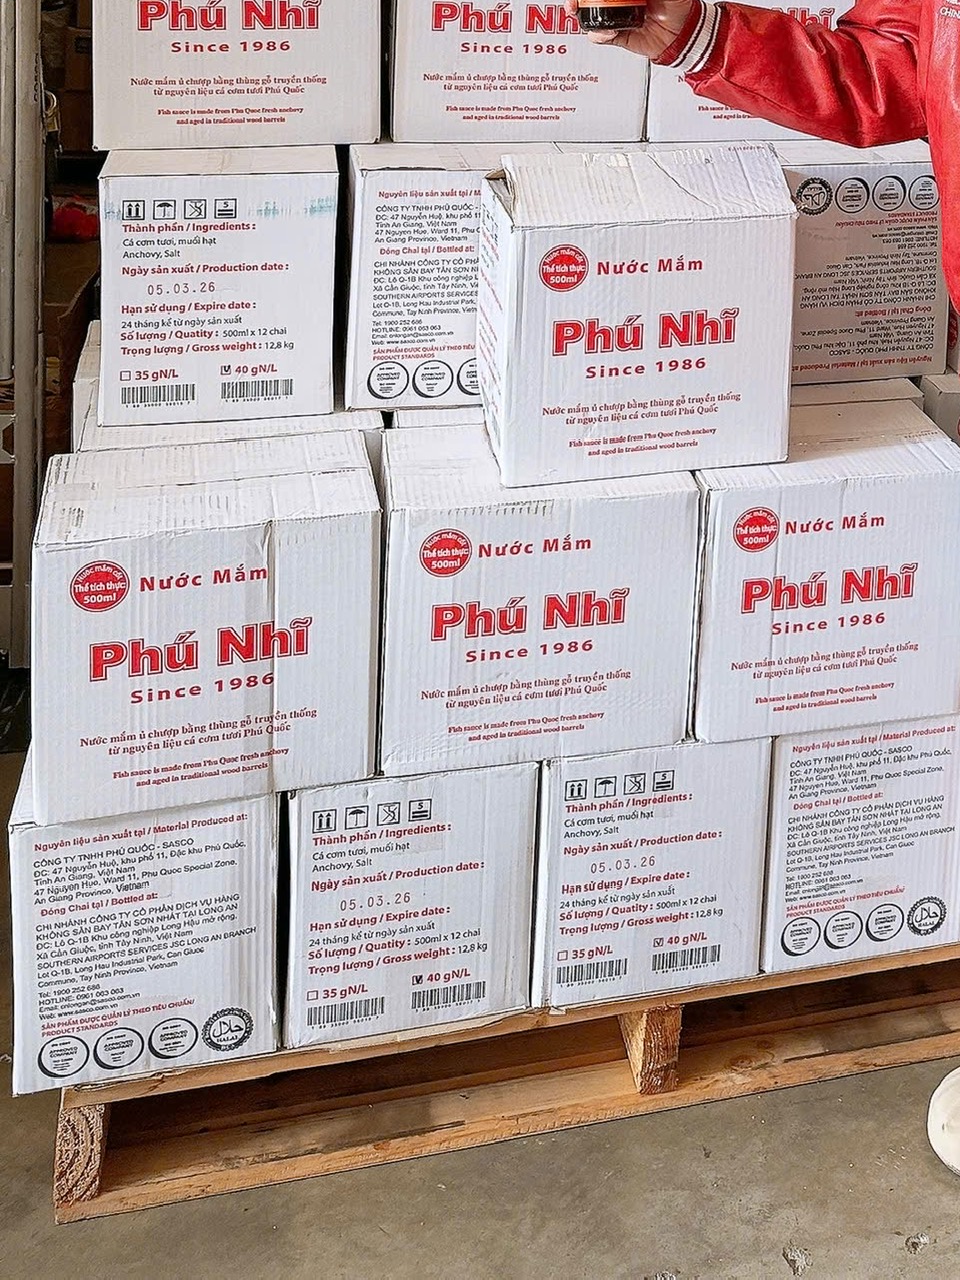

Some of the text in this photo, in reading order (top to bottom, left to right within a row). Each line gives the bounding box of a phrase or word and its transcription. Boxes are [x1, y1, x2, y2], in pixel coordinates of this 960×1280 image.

[431, 0, 587, 34] Phú Nh
[169, 40, 292, 54] Since 1986
[460, 42, 568, 56] Since 1986
[123, 236, 217, 247] Cá cơm tươi, muối hạt
[122, 250, 163, 260] Anchovy,
[595, 257, 703, 276] Nước Mắm
[147, 282, 216, 295] 05.03.26
[552, 308, 740, 357] Phú Nhĩ
[135, 369, 179, 381] 35 gN/L
[586, 358, 707, 379] Since 1986
[784, 513, 885, 535] Nước Mắm
[478, 537, 592, 557] Nước Mắm
[139, 565, 268, 592] Nước Mắm
[740, 564, 916, 614] Phú Nhĩ
[431, 588, 629, 642] Phú Nhĩ
[771, 612, 886, 635] Since 1986
[89, 618, 312, 681] Phú Nhĩ
[466, 640, 592, 663] Since 1986
[131, 674, 273, 704] Since 1986
[80, 736, 108, 747] Nước
[110, 732, 137, 743] mắm
[148, 727, 179, 741] chượp
[181, 724, 207, 735] bằng
[208, 719, 238, 731] thùng
[240, 715, 252, 728] gỗ
[254, 712, 288, 726] truyền
[289, 707, 317, 719] thống
[108, 722, 292, 756] từ nguyên liệu cá cơm tươi Phú Quốc
[590, 856, 656, 874] 05.03.26
[340, 892, 411, 911] 05.03.26
